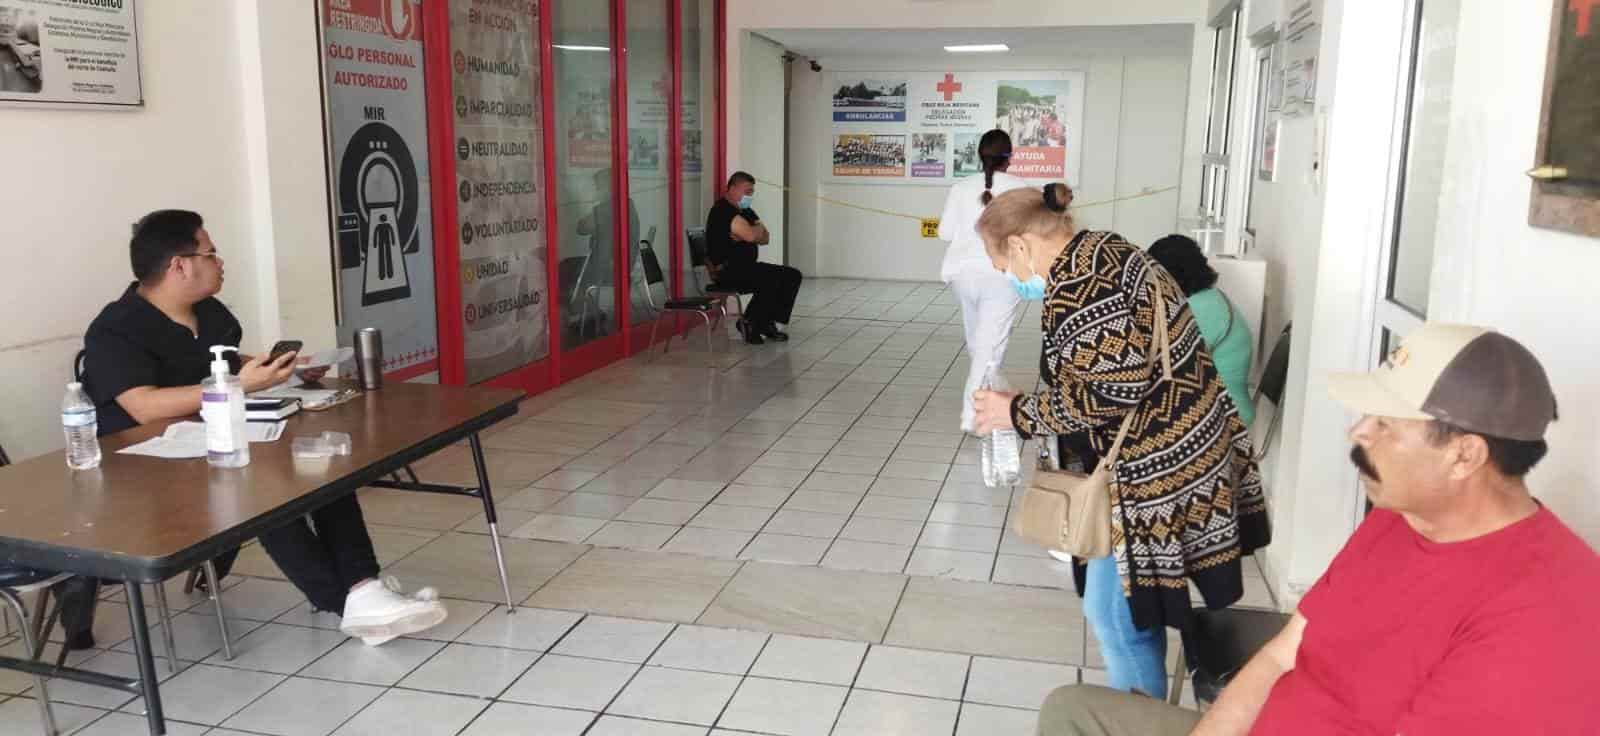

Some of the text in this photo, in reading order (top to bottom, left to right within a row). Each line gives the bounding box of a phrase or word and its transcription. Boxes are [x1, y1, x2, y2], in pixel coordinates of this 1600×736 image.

[328, 41, 416, 68] ÓLO PERSONAL
[468, 55, 520, 77] HUMANIDAD
[335, 71, 408, 91] AUTORIZADO
[363, 105, 385, 121] MIR
[470, 99, 533, 119] IMPARCIALIDAD
[472, 142, 529, 157] NEUTRALIDAD
[1014, 151, 1046, 161] AYUDA
[473, 181, 537, 198] INDEPENDENCIA
[475, 218, 538, 239] VOLUNTARIADO
[476, 260, 509, 279] UNIDAD
[478, 291, 541, 319] UNIVERSALIDAD
